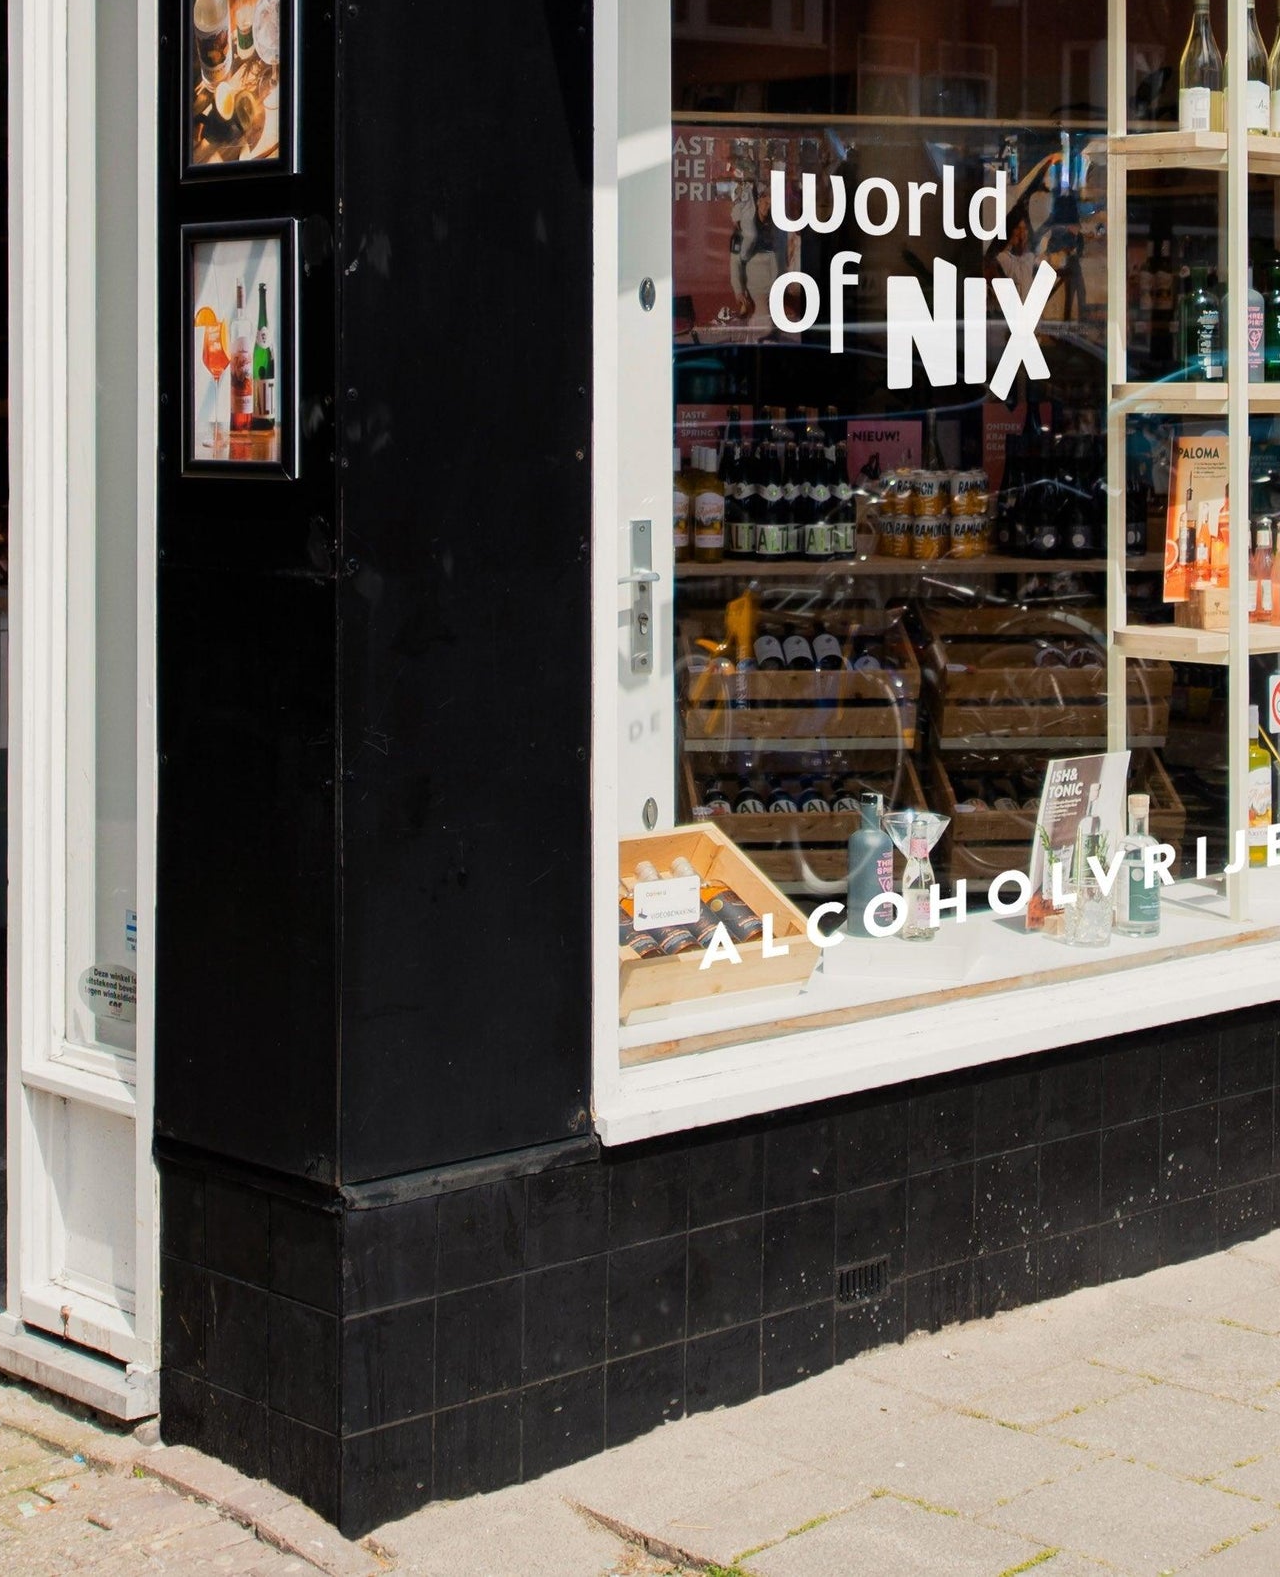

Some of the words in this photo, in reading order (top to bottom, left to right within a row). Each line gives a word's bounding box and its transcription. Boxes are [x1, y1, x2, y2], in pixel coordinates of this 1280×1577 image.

[769, 165, 1008, 241] world
[768, 251, 863, 354] of
[886, 256, 1058, 401] NIX
[852, 430, 900, 442] NIEUW!
[1177, 447, 1220, 459] PALOMA
[1052, 767, 1078, 783] ISH&
[1048, 782, 1084, 799] TONIC
[94, 968, 109, 978] Deze
